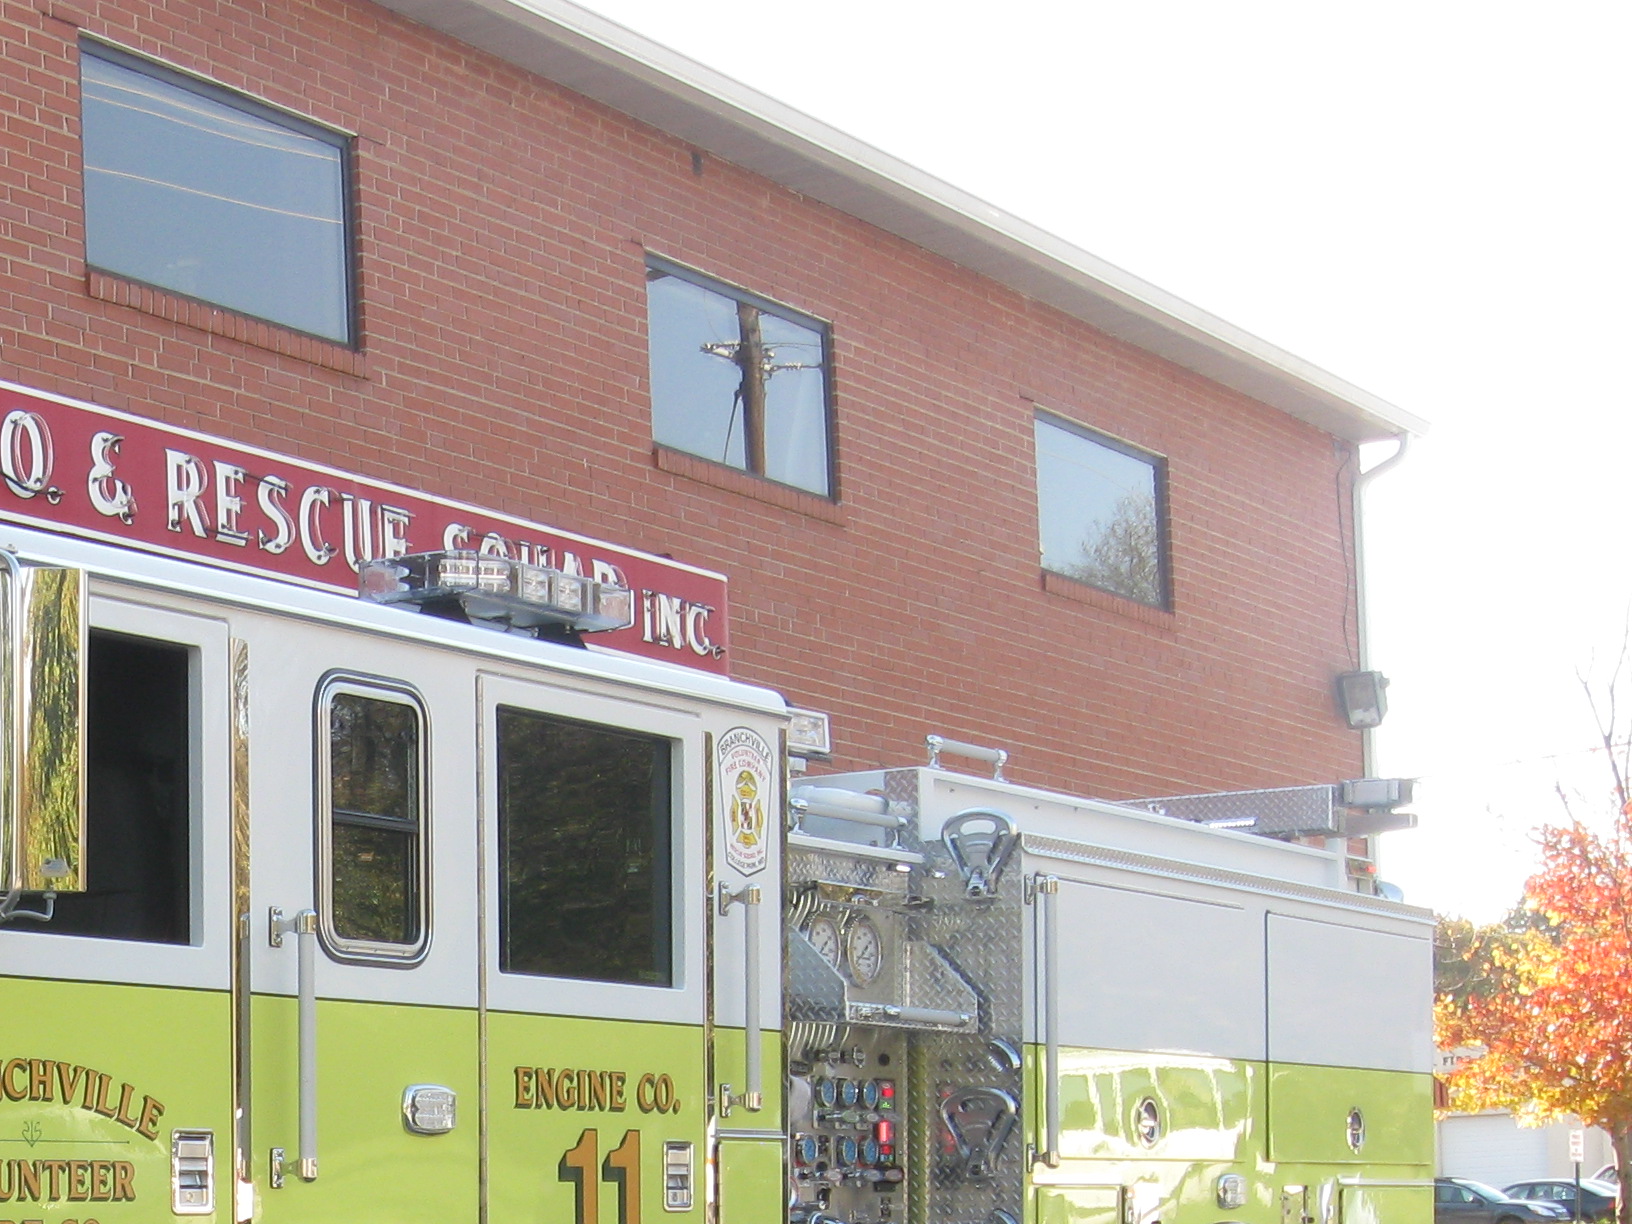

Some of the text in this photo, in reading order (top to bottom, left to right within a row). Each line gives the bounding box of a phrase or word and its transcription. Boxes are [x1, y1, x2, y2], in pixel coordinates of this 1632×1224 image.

[87, 430, 137, 525] &
[720, 731, 771, 761] BRANCHVILLE
[514, 1066, 681, 1114] ENGINE CO.
